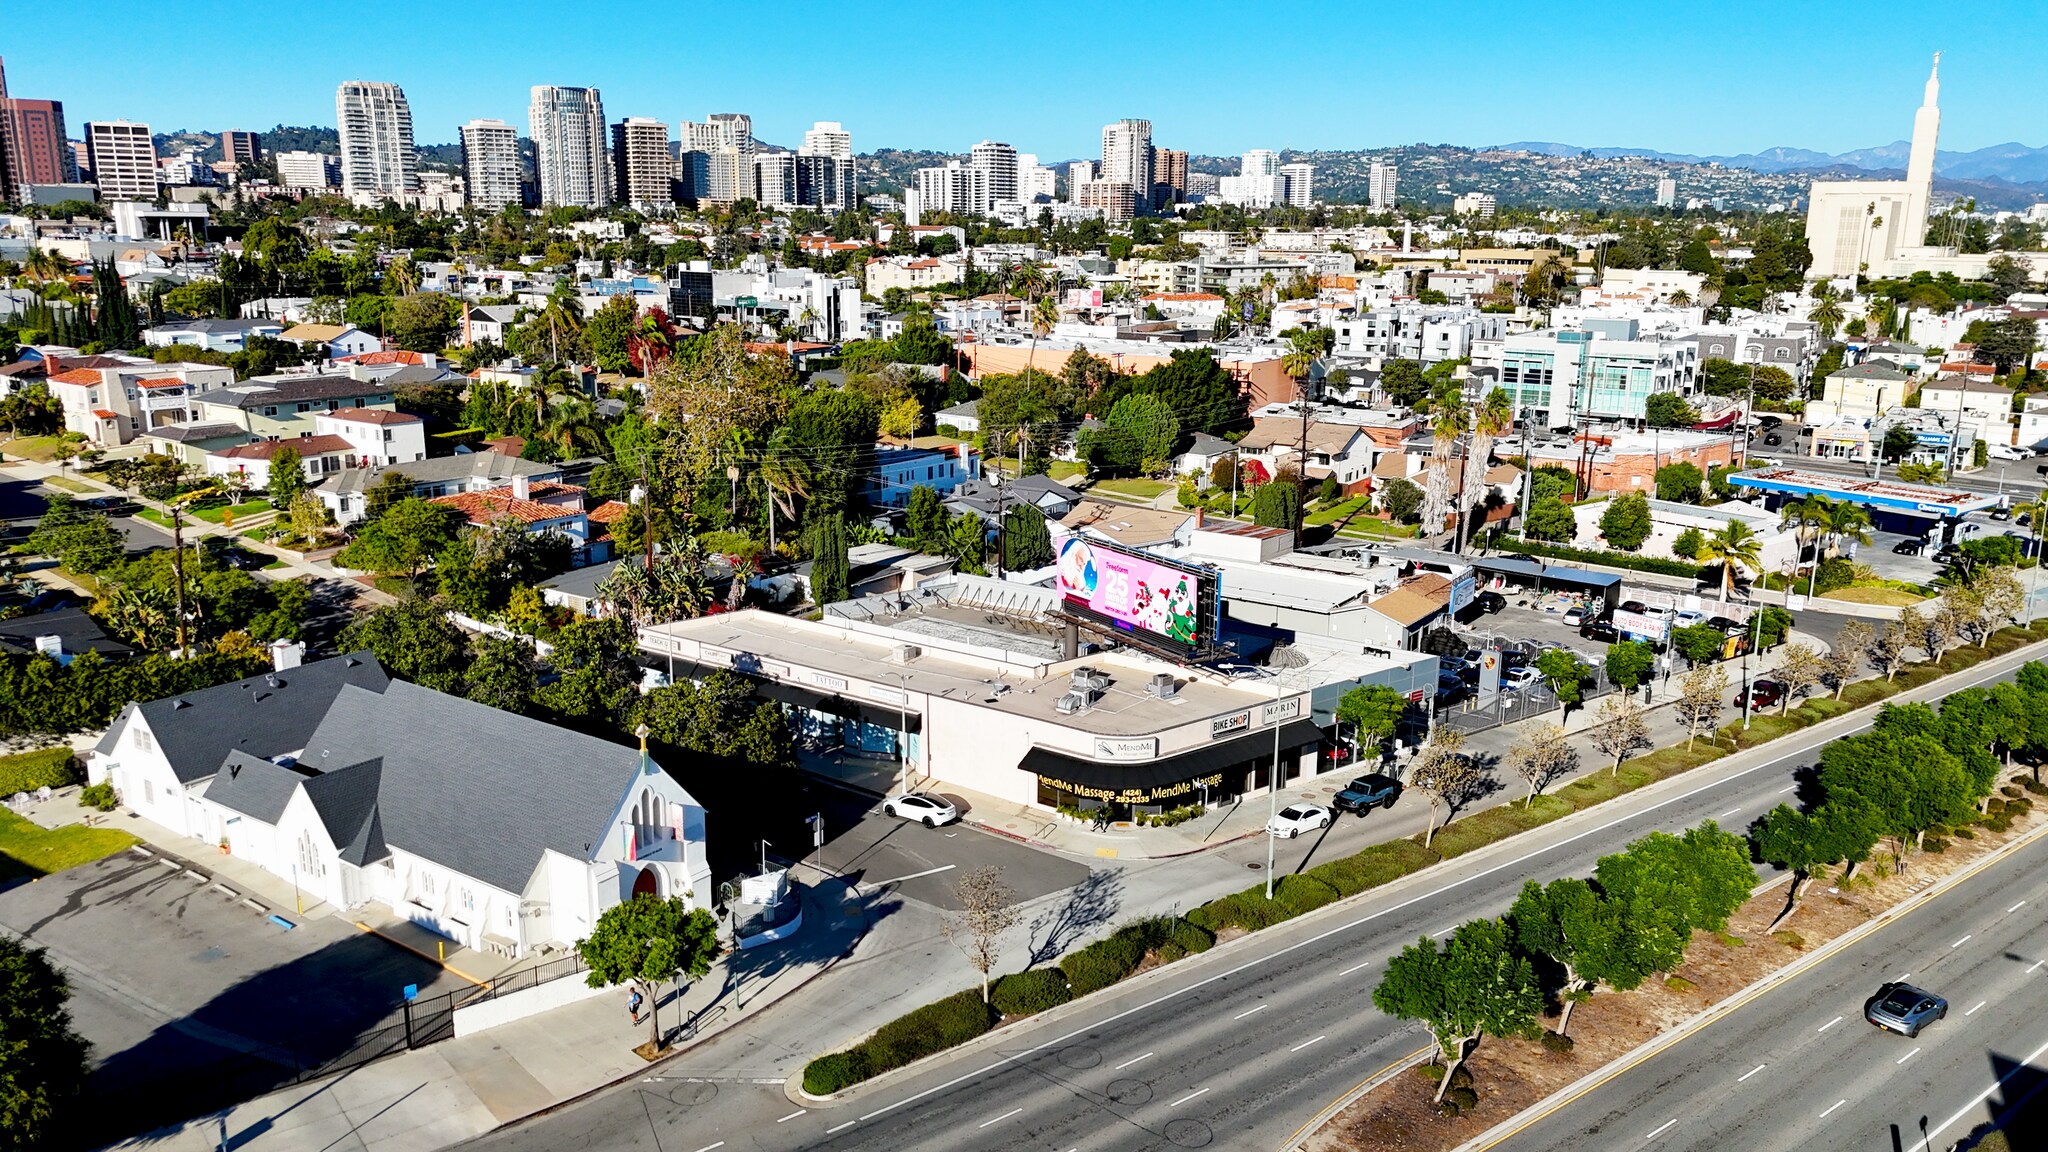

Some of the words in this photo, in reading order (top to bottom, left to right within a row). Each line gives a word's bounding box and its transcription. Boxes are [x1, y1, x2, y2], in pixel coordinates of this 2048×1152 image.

[1917, 503, 1950, 514] Chevron
[1105, 571, 1128, 597] 25
[1614, 617, 1627, 625] AUTO
[1629, 620, 1642, 628] BODY
[1649, 624, 1664, 632] PAINT
[815, 675, 843, 688] TATTOO
[1213, 718, 1228, 732] BIKE
[1229, 714, 1247, 727] SHOP
[1074, 784, 1115, 802] Massage
[1122, 789, 1142, 797] (424)
[1151, 782, 1191, 799] MendMe
[1192, 772, 1223, 791] Massage
[1115, 796, 1150, 804] 293-0335
